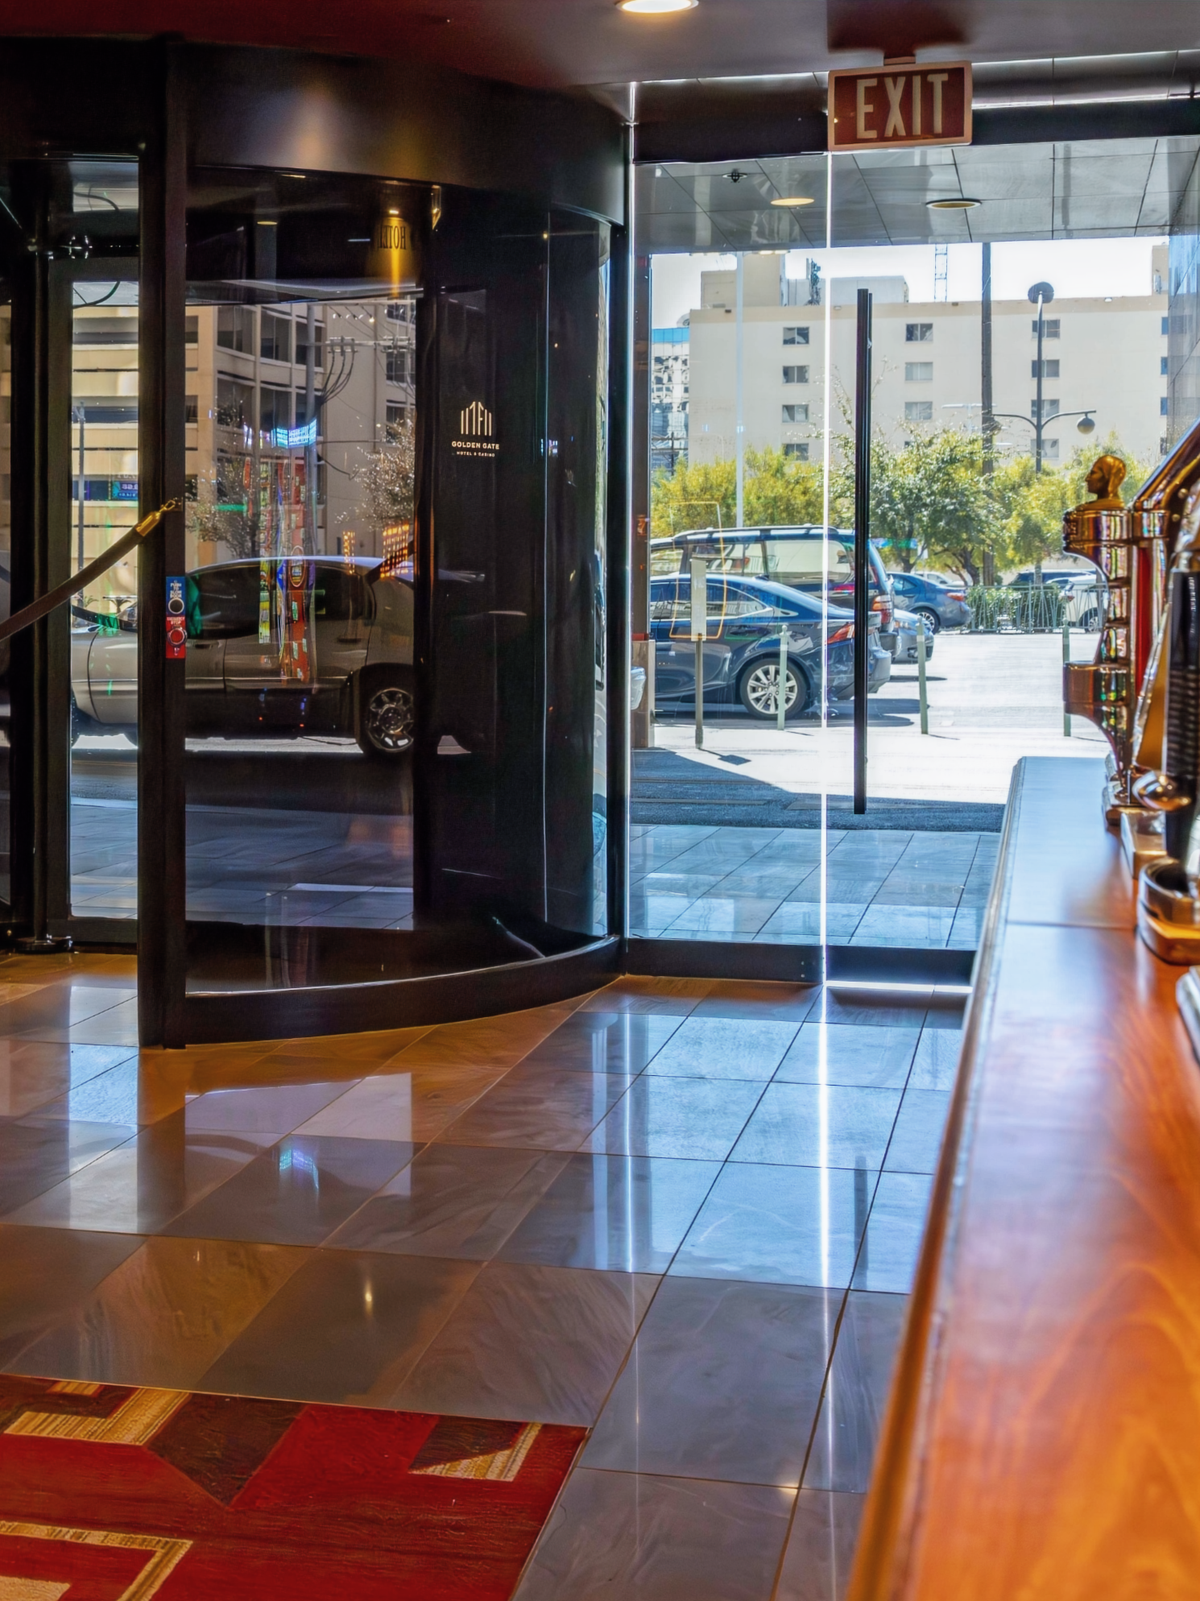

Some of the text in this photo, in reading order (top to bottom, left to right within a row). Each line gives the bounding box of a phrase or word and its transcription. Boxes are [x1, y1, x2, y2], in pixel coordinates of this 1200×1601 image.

[856, 73, 949, 139] EXIT
[451, 440, 500, 450] GOLDEN GATE
